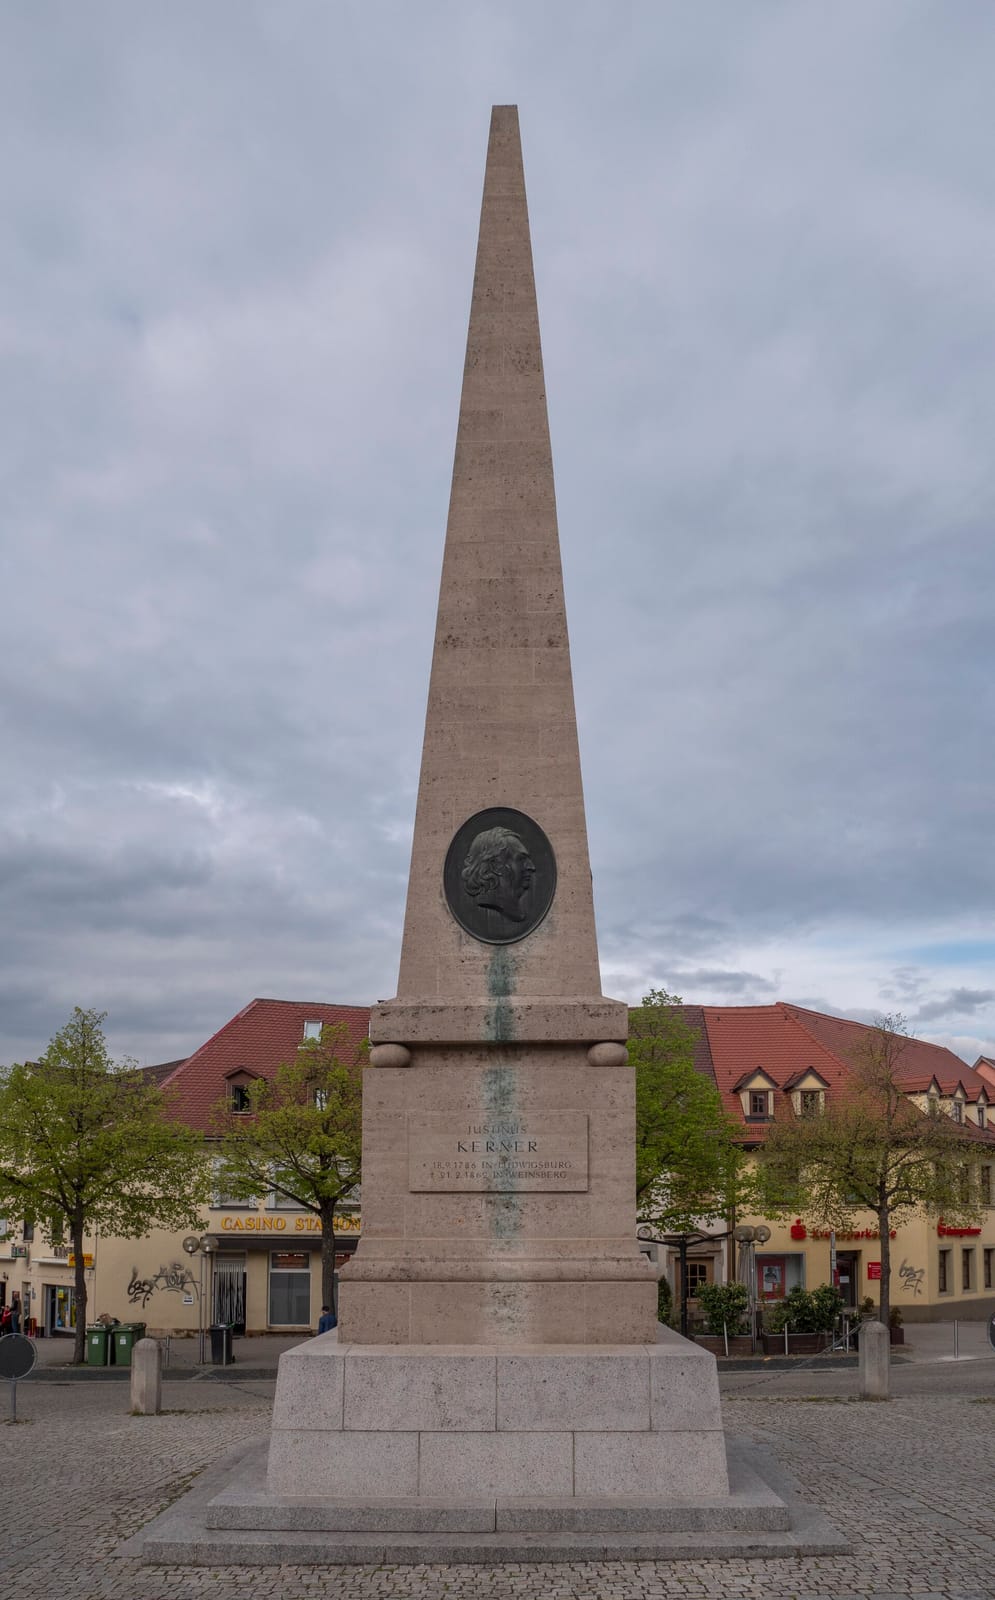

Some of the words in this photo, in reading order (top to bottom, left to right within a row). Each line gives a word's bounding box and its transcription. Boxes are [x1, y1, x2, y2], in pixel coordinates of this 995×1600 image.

[466, 1124, 529, 1135] JUSTINUS
[457, 1141, 538, 1153] KERNER
[481, 1161, 493, 1169] IN
[498, 1161, 573, 1169] LUDWIGSBURG
[507, 1170, 567, 1180] WEINSBERG
[221, 1216, 287, 1232] CASINO
[295, 1216, 362, 1232] STAION
[811, 1228, 897, 1240] Kressparkae
